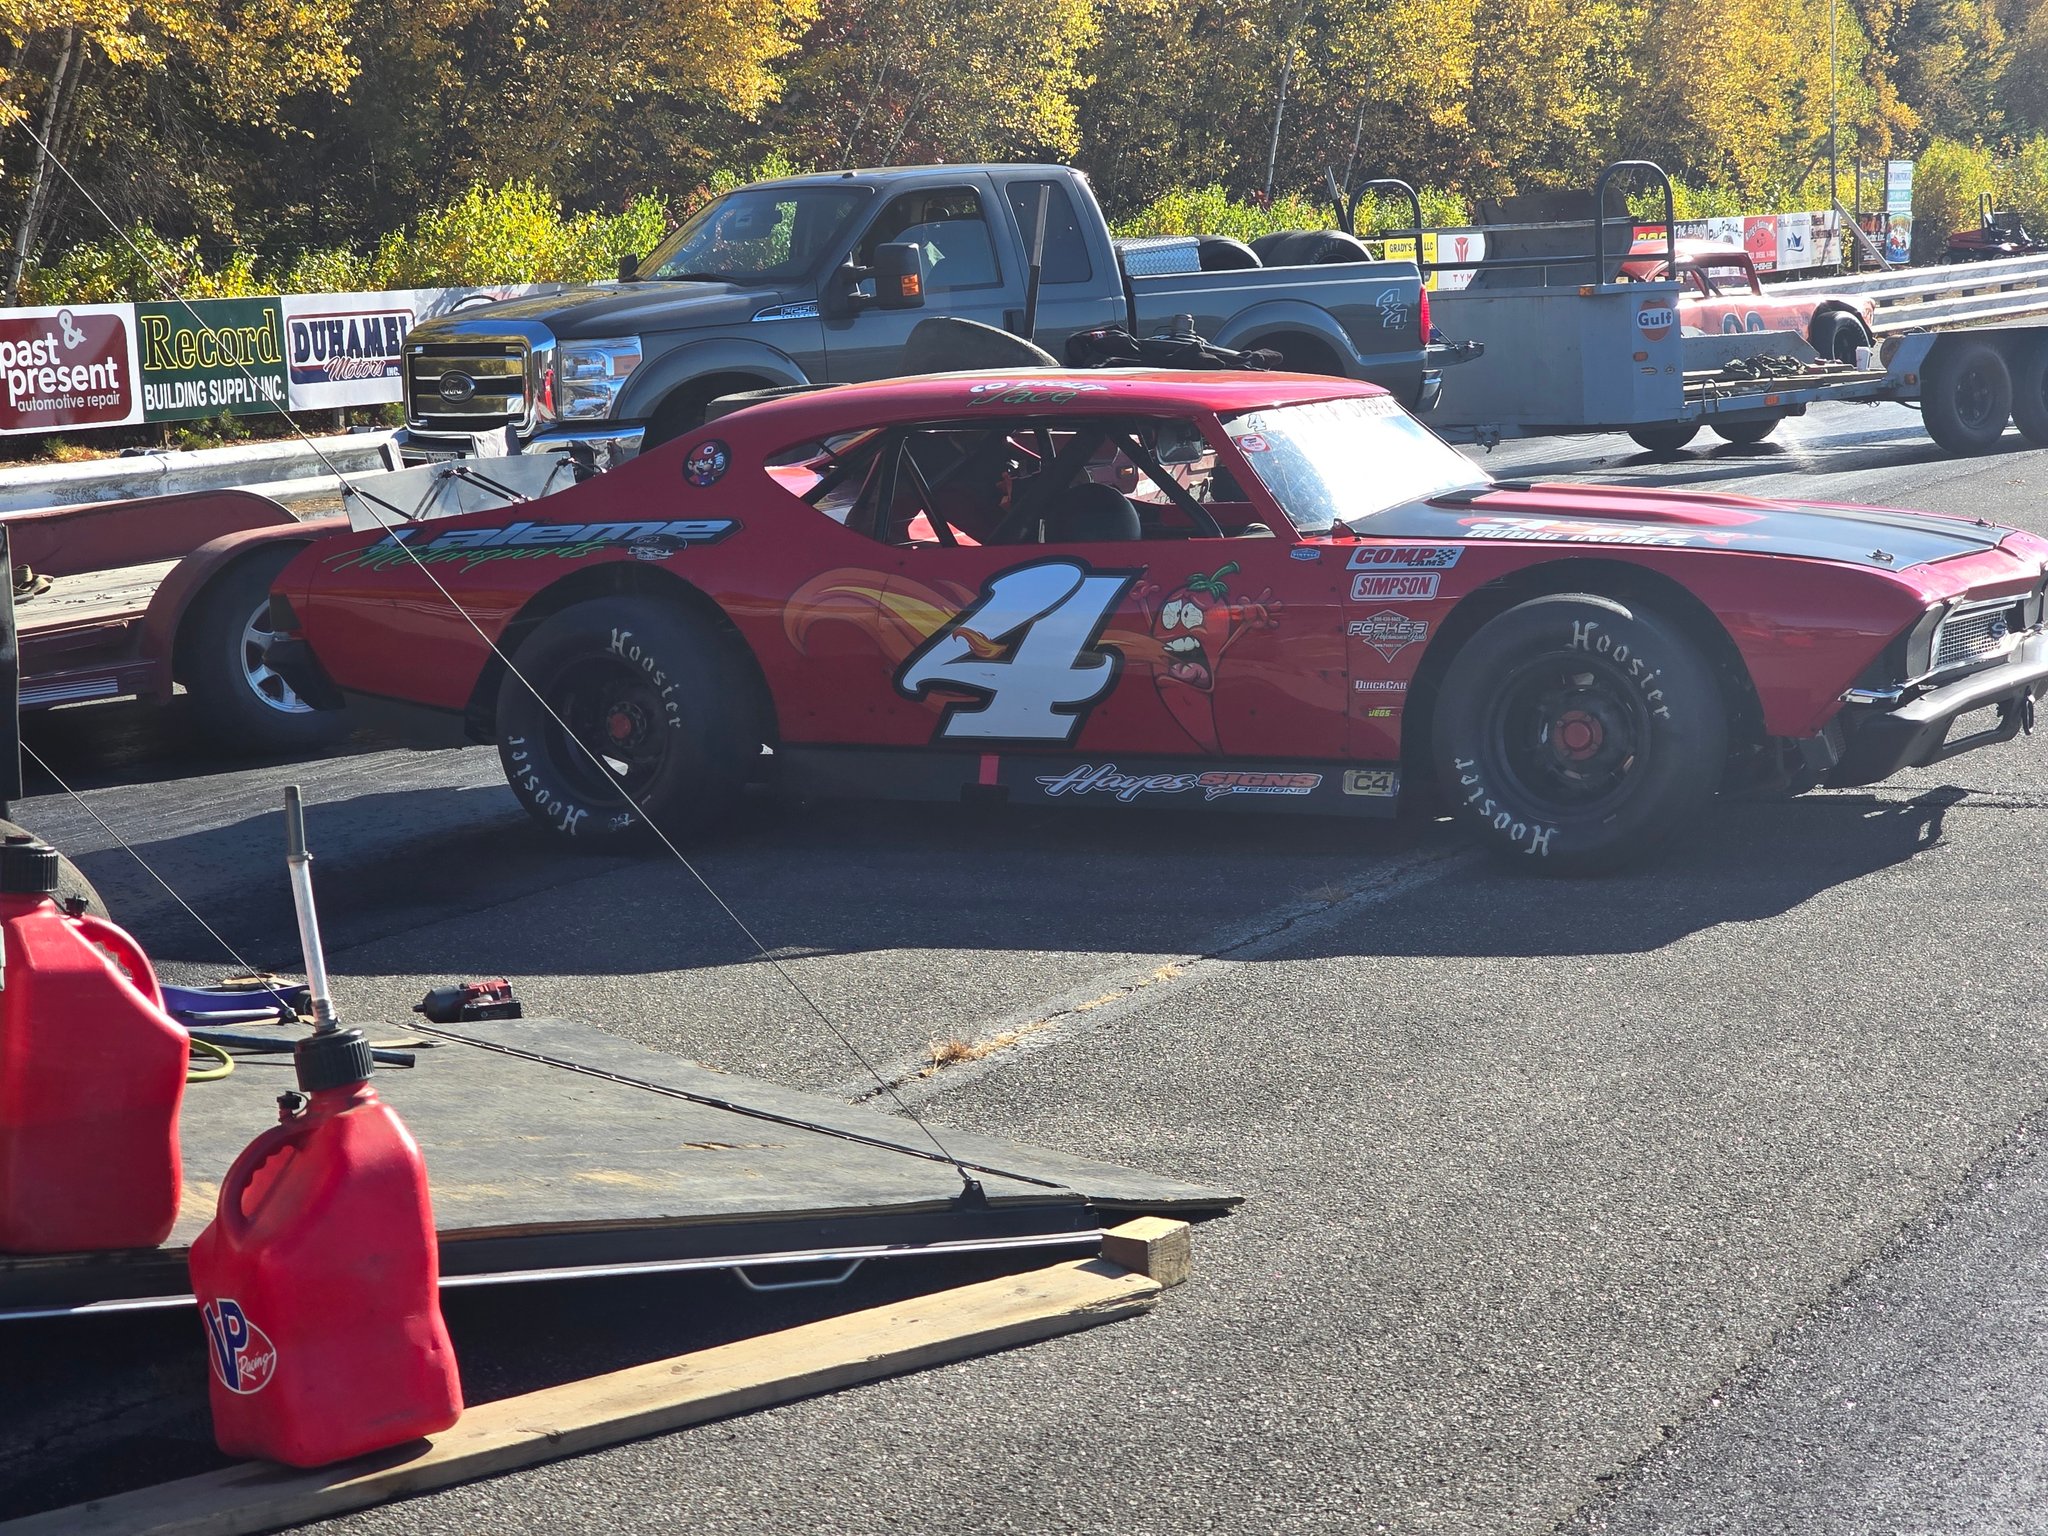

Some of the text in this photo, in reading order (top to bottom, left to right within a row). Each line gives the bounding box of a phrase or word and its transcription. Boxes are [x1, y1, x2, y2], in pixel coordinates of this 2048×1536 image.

[1389, 243, 1412, 253] GRADY'S
[1424, 242, 1434, 251] LLC
[1637, 312, 1672, 326] Gulf
[0, 309, 88, 379] past &
[141, 308, 282, 370] Record
[7, 356, 120, 408] present
[323, 355, 387, 382] Motors
[17, 391, 121, 412] automotive repair
[144, 375, 286, 411] BUILDING SUPPLY INC.
[1355, 548, 1437, 564] COMP
[1407, 559, 1447, 567] CAMS
[1357, 577, 1432, 596] SIMPSON
[897, 557, 1136, 744] 4
[607, 628, 681, 728] Hoosier
[1566, 620, 1671, 719] Hoosier
[508, 735, 589, 836] Hoosier
[1037, 763, 1323, 801] Hayes SIGNS
[1236, 787, 1309, 795] DESIGNS
[1353, 774, 1391, 792] C4
[1454, 757, 1560, 857] Hoosier
[203, 1298, 249, 1392] VP
[239, 1351, 271, 1383] Racing
